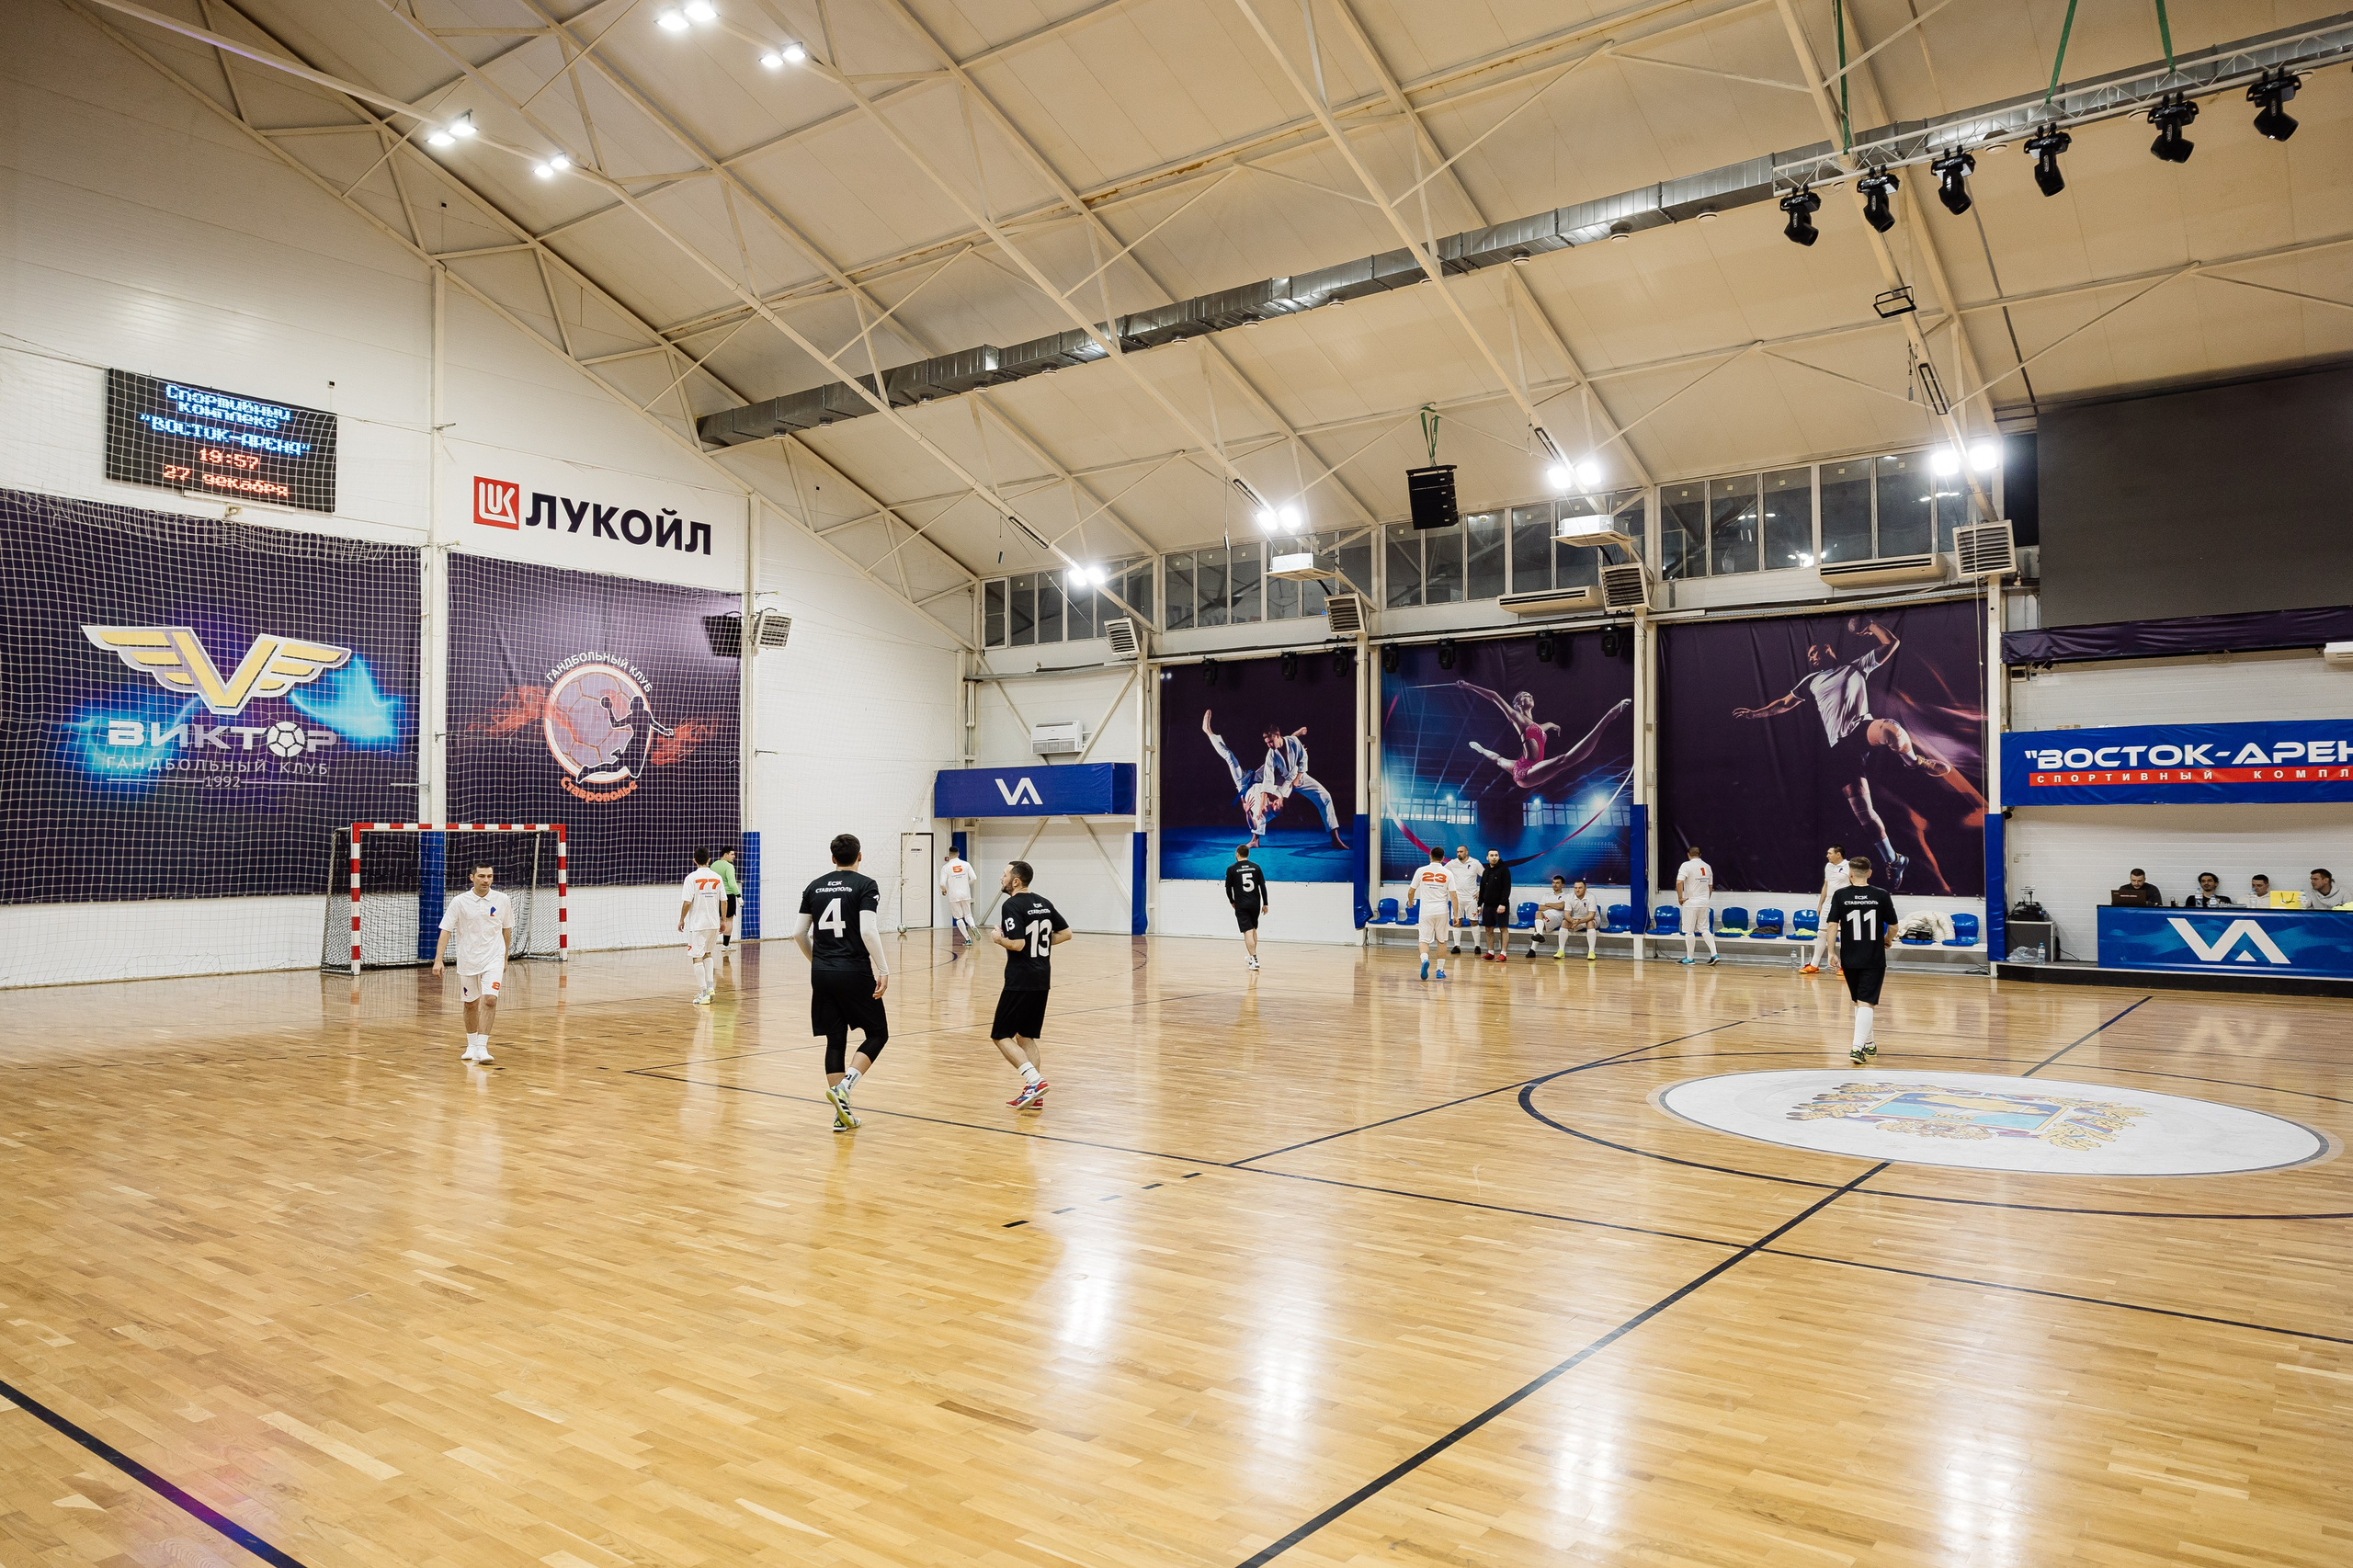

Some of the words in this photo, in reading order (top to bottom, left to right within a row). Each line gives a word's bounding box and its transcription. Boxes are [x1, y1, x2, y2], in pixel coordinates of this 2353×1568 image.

[199, 449, 259, 470] 19:57
[164, 464, 191, 480] 27
[202, 473, 288, 496] декабря
[526, 492, 711, 556] ЛУКОЙЛ
[546, 651, 629, 683] ГАНДБОЛЬНЫЙ
[629, 665, 652, 693] КЛУБ
[108, 720, 337, 757] ВИКТОР
[107, 756, 267, 773] ГАНДБОЛЬНЫЙ
[279, 760, 329, 775] КЛУБ
[204, 776, 241, 788] 1992
[2037, 769, 2213, 783] СПОРТИВНЫЙ
[561, 777, 638, 803] Ставрополье
[952, 865, 963, 873] 5
[1422, 872, 1447, 883] 23
[1700, 867, 1706, 876] 1
[695, 878, 721, 890] 77
[1242, 872, 1255, 892] 5
[818, 897, 847, 937] 4
[1005, 917, 1016, 931] 13
[1846, 909, 1877, 940] 11
[1025, 918, 1052, 958] 13
